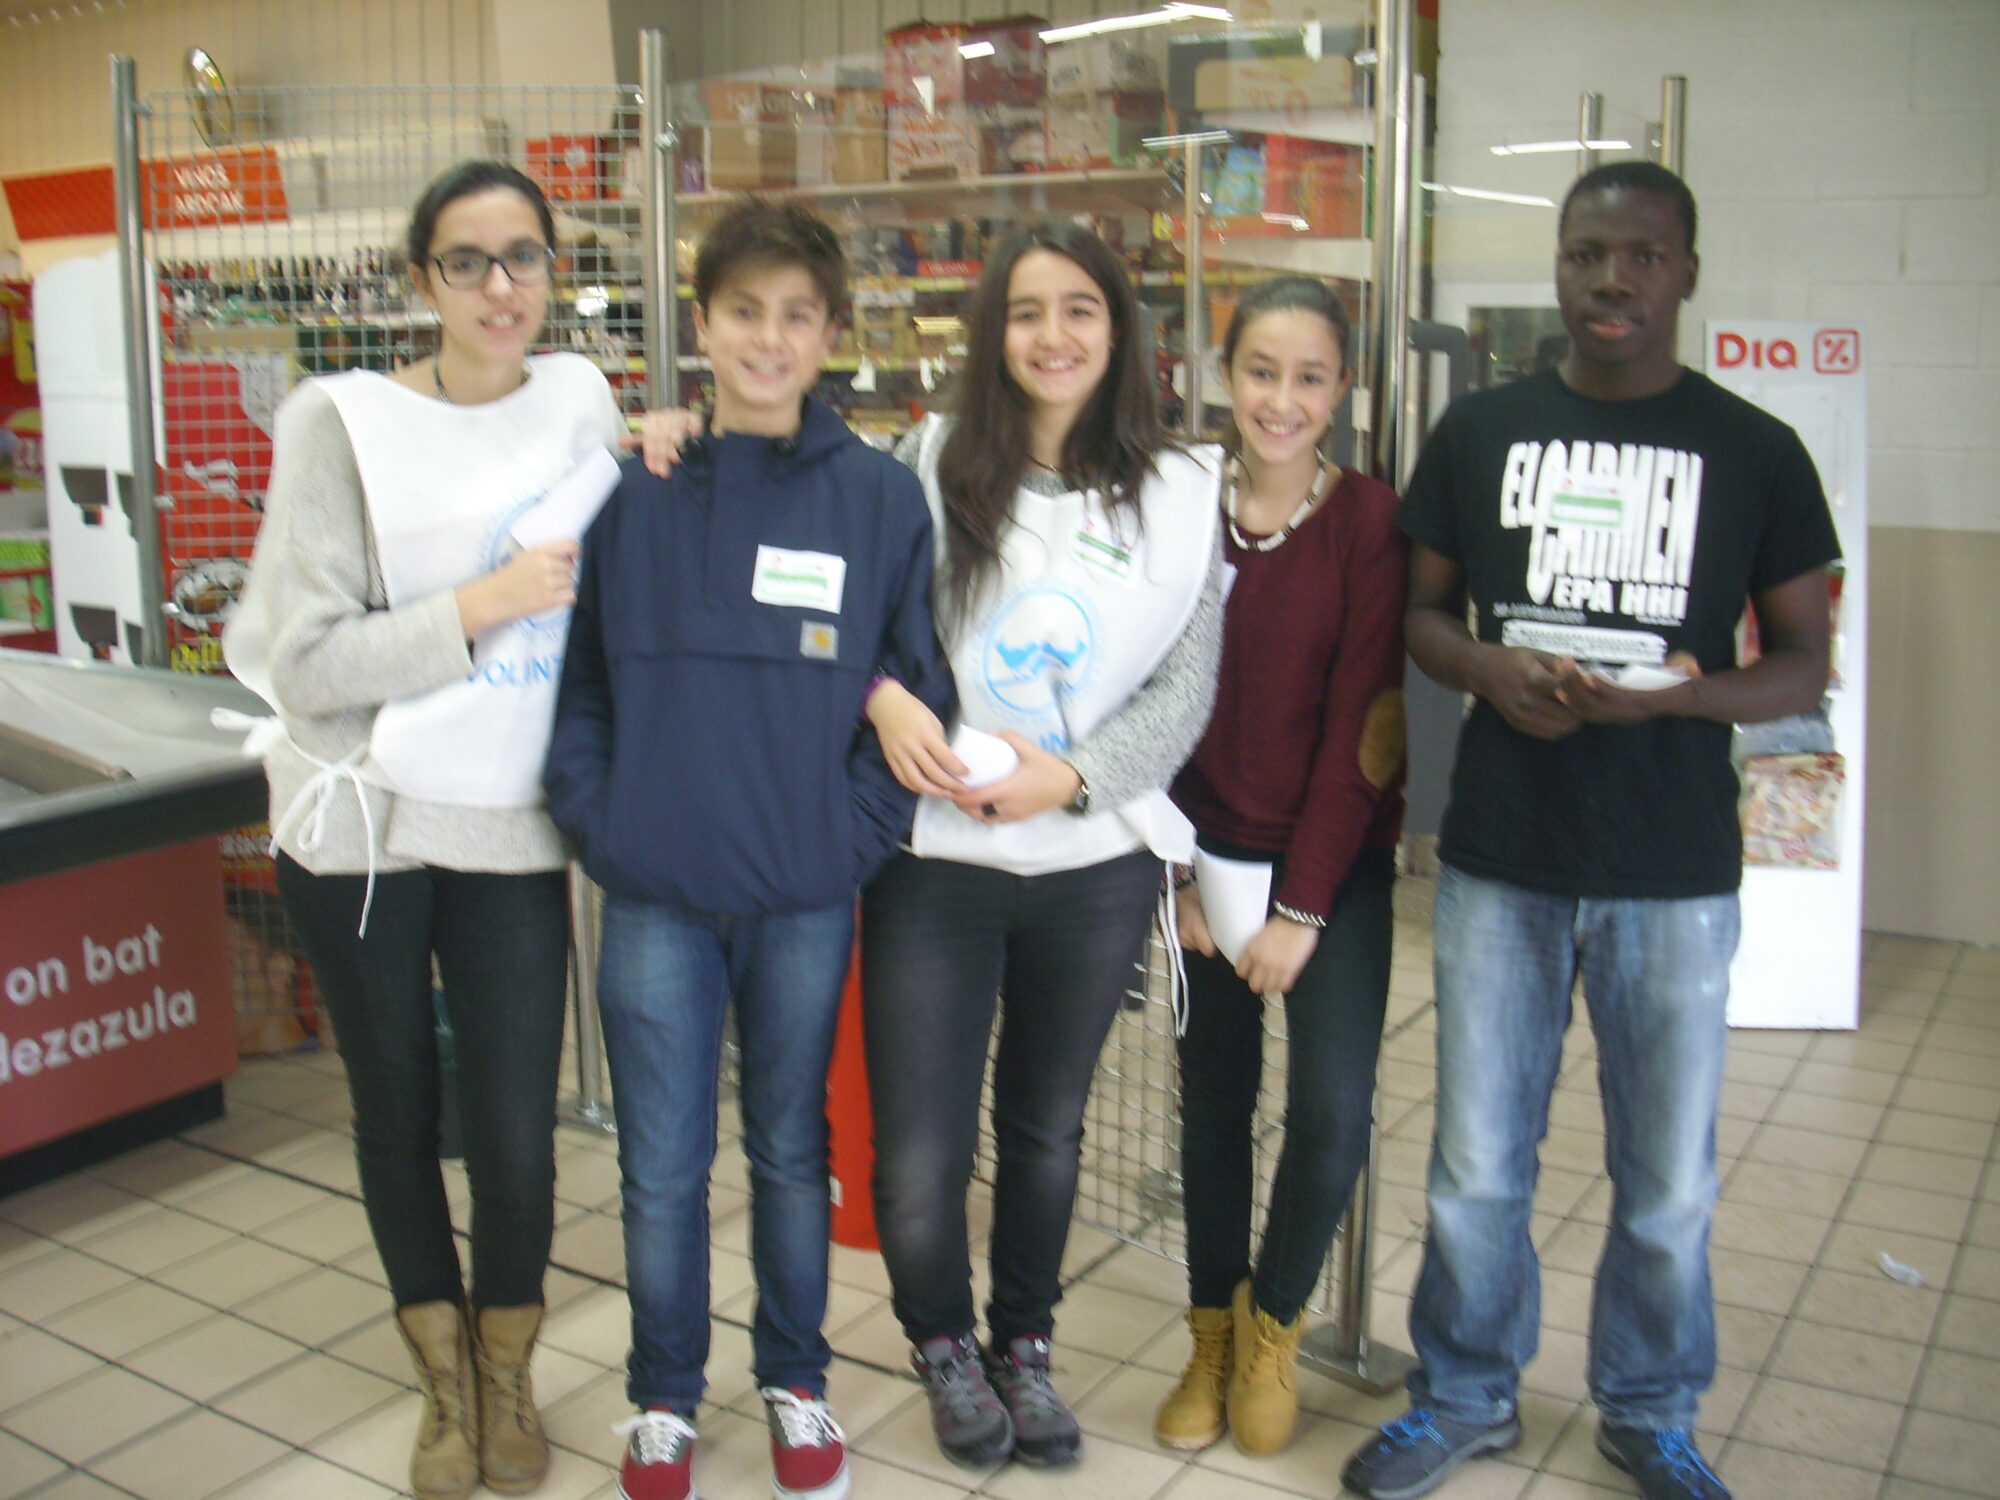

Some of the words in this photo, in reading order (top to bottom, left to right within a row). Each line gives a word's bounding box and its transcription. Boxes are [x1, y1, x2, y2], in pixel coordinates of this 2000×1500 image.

[174, 163, 231, 189] VINOS
[1552, 574, 1615, 614] EPA
[5, 957, 68, 1006] on
[82, 922, 163, 986] bat
